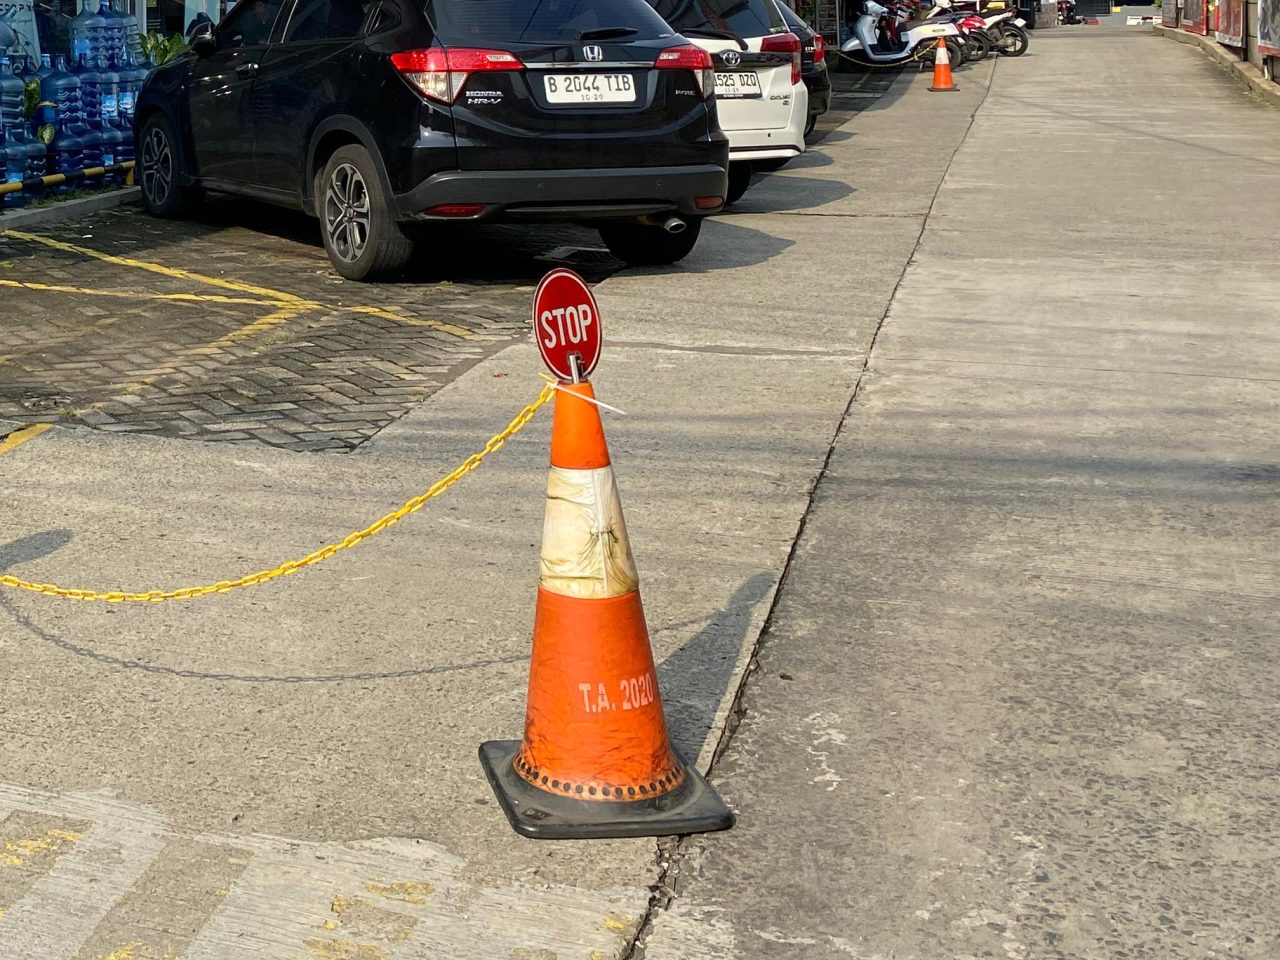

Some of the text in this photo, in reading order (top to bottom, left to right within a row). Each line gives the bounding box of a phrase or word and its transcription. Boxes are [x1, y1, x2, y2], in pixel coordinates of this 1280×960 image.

[548, 75, 631, 93] B 2044 TIB
[739, 74, 757, 86] DZQ
[540, 303, 593, 348] STOP
[619, 673, 653, 710] 2020
